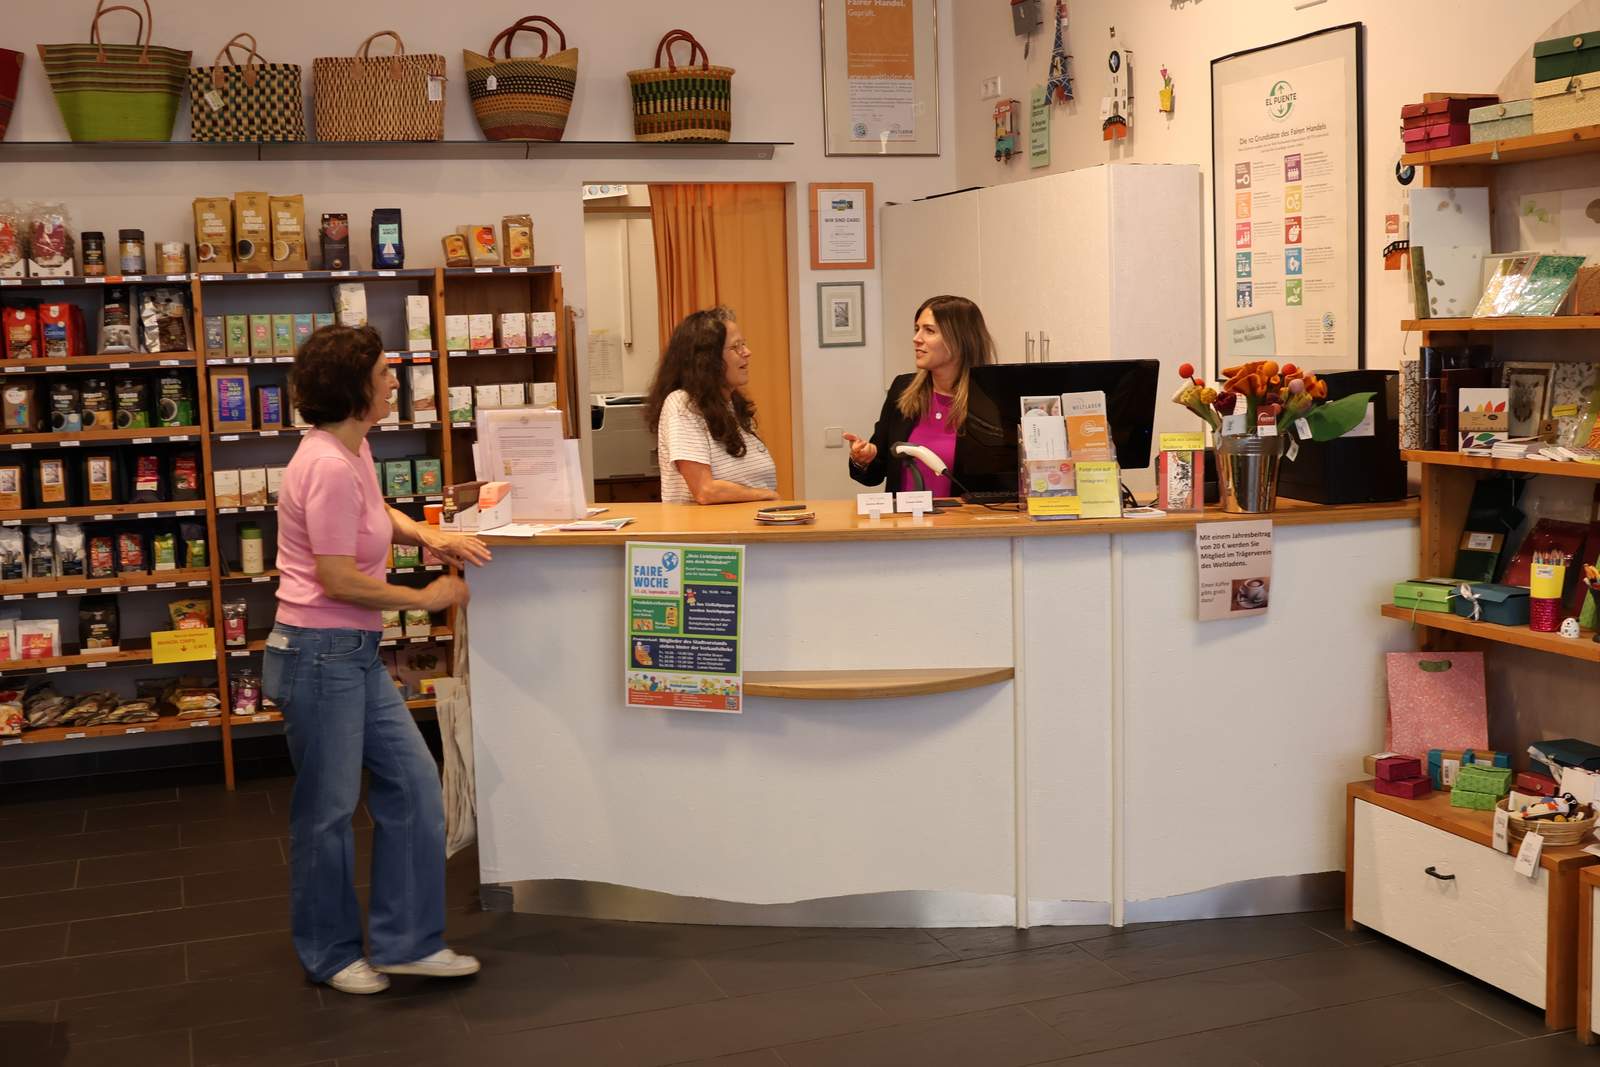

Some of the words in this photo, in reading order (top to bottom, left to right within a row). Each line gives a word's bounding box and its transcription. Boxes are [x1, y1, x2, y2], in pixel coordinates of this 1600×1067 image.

[1265, 98, 1273, 106] EL
[1273, 92, 1297, 105] PUENTE
[1232, 531, 1271, 539] Jahresbeitrag
[1200, 552, 1225, 560] Mitglied
[1236, 550, 1271, 558] Trägerverein
[1212, 560, 1247, 568] Weltladens.
[634, 565, 663, 577] FAIRE
[634, 577, 669, 588] WOCHE
